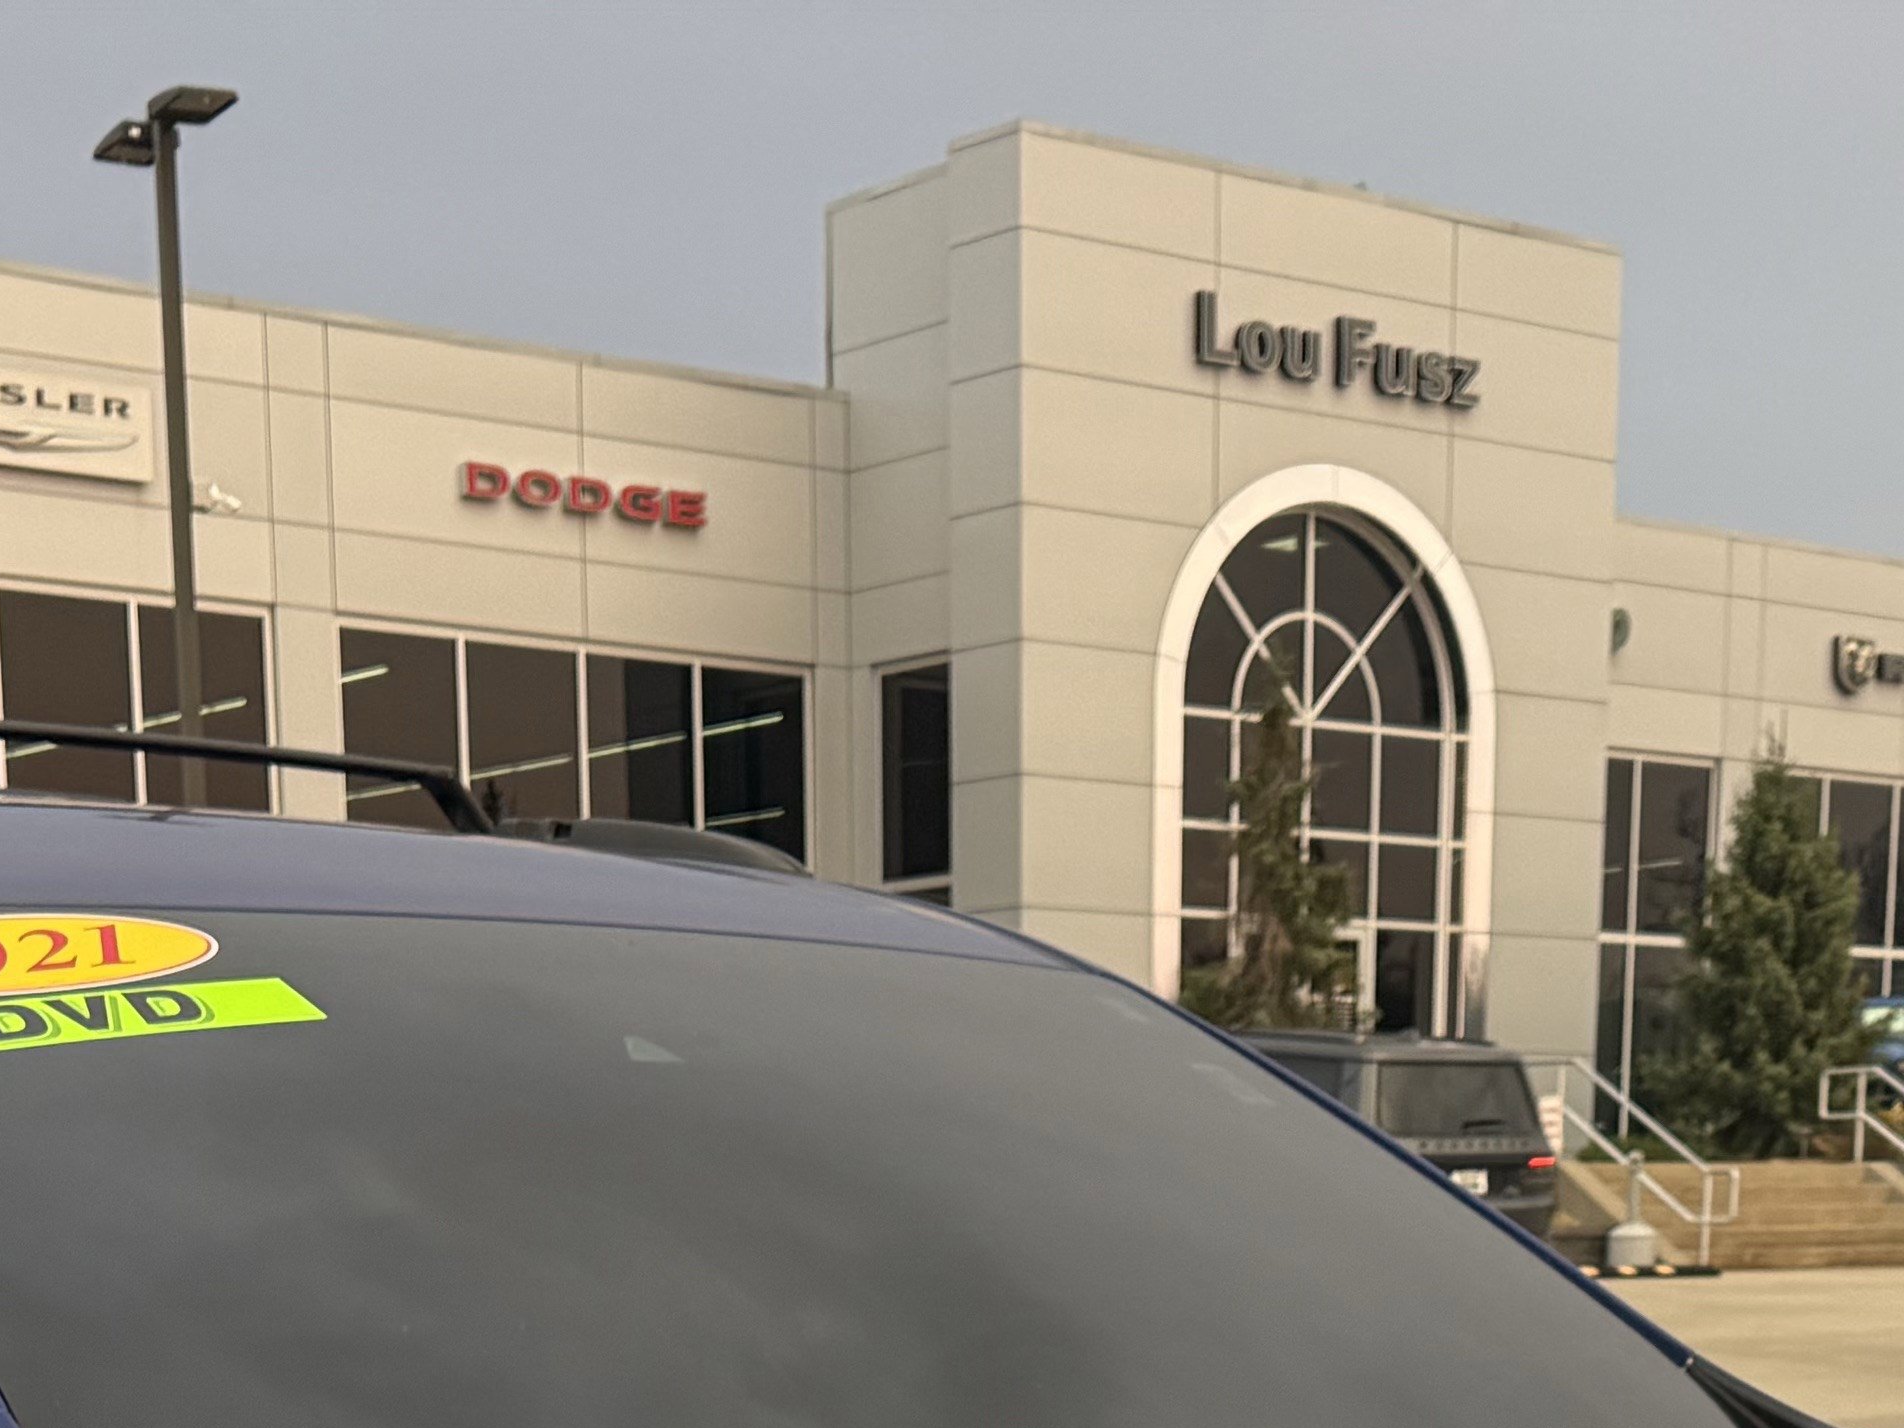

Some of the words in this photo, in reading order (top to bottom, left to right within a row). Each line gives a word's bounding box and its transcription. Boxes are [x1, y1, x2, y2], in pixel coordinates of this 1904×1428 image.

[1193, 289, 1322, 384] Lou
[1334, 314, 1482, 409] Fusz
[459, 460, 709, 528] DODGE
